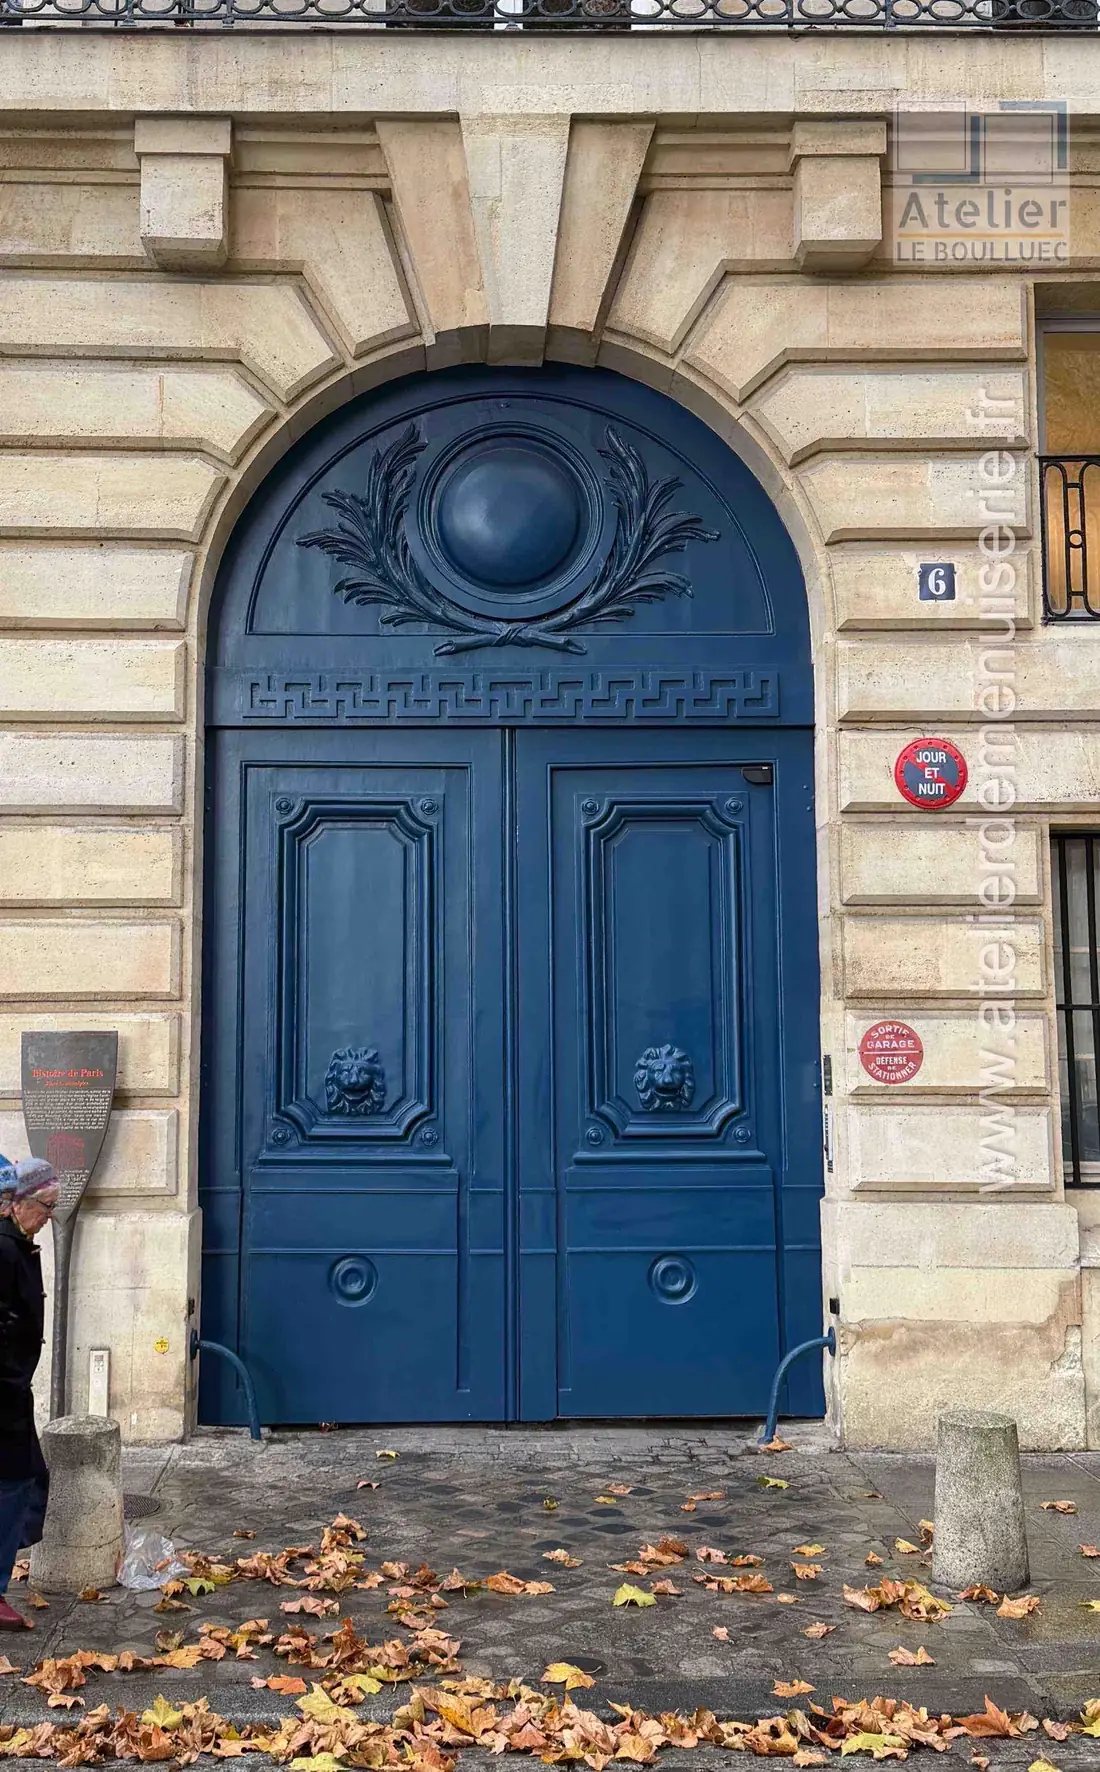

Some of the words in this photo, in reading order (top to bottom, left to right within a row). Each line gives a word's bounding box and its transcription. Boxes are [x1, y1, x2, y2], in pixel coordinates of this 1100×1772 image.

[928, 568, 946, 595] 6
[916, 751, 946, 763] JOUR
[924, 767, 940, 779] ET
[918, 783, 946, 795] NUIT
[871, 1025, 909, 1039] SORTIE
[867, 1040, 914, 1048] GARAGE
[80, 1068, 104, 1077] Paris
[869, 1062, 916, 1080] STATIONNER
